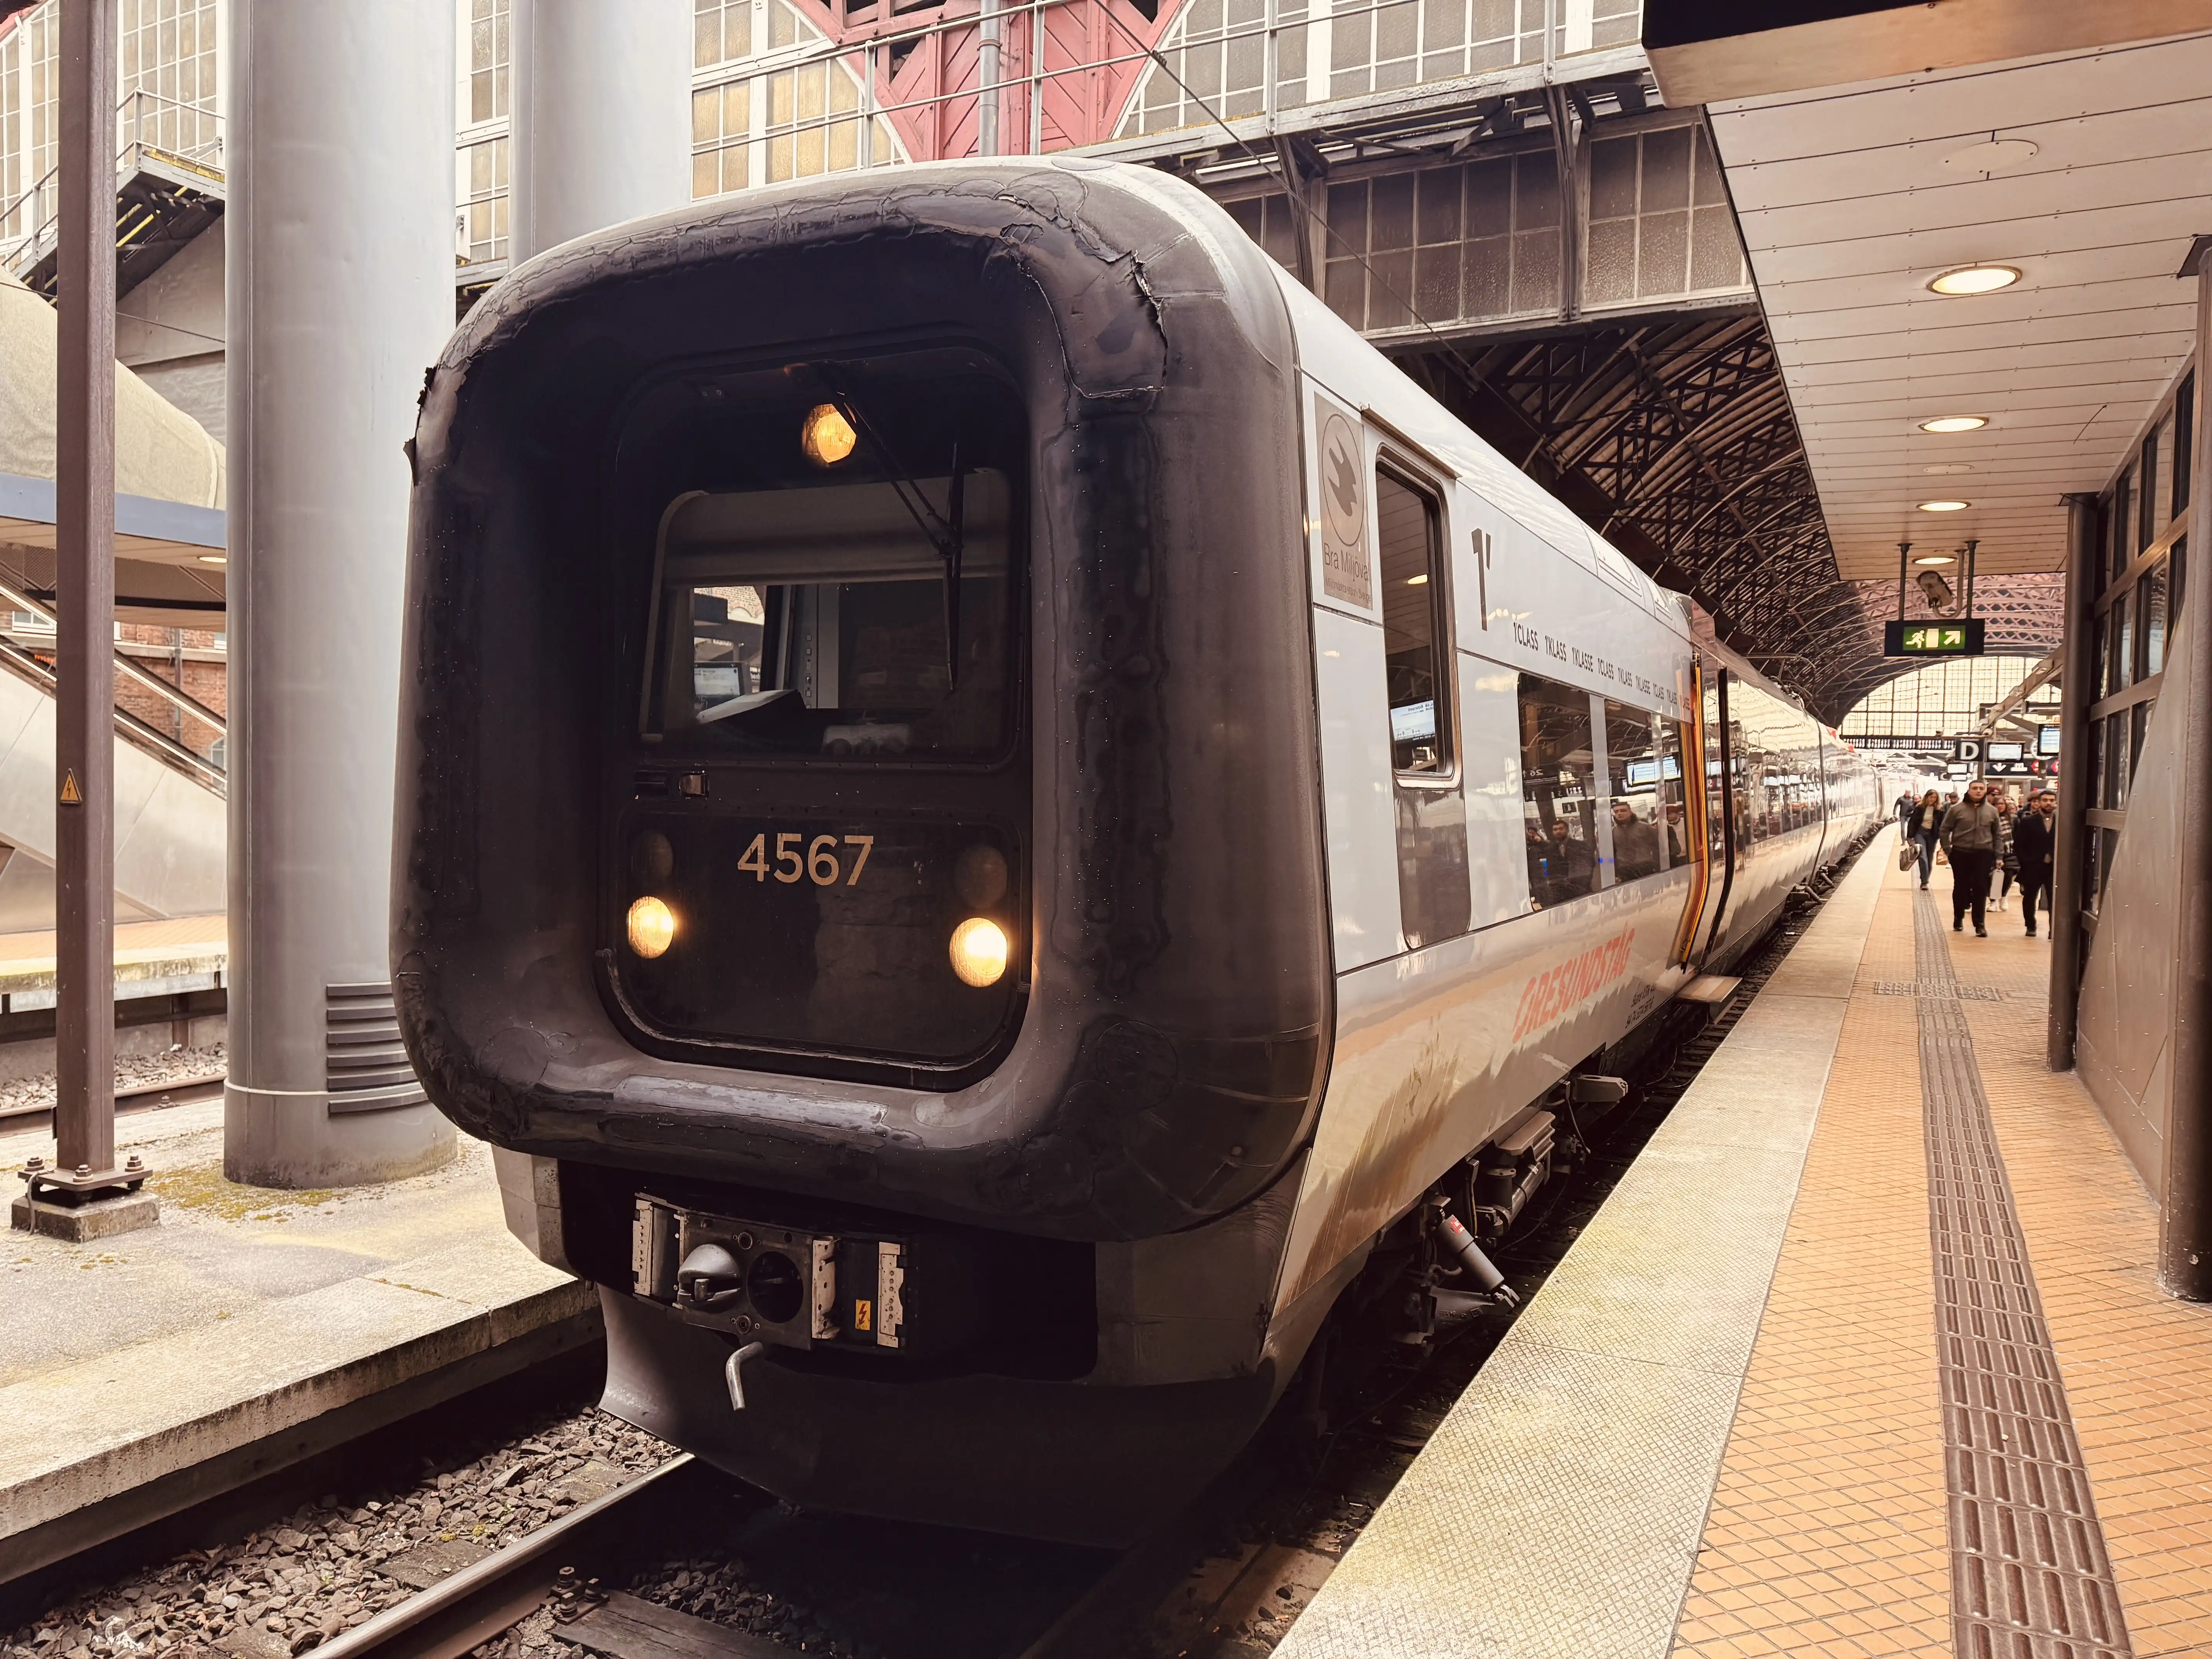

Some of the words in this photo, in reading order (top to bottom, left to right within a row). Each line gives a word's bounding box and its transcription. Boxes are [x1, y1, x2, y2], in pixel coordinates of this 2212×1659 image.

[1324, 543, 1339, 570] Bra
[1341, 550, 1371, 582] Miljöval
[1960, 742, 1979, 760] D
[737, 832, 874, 886] 4567
